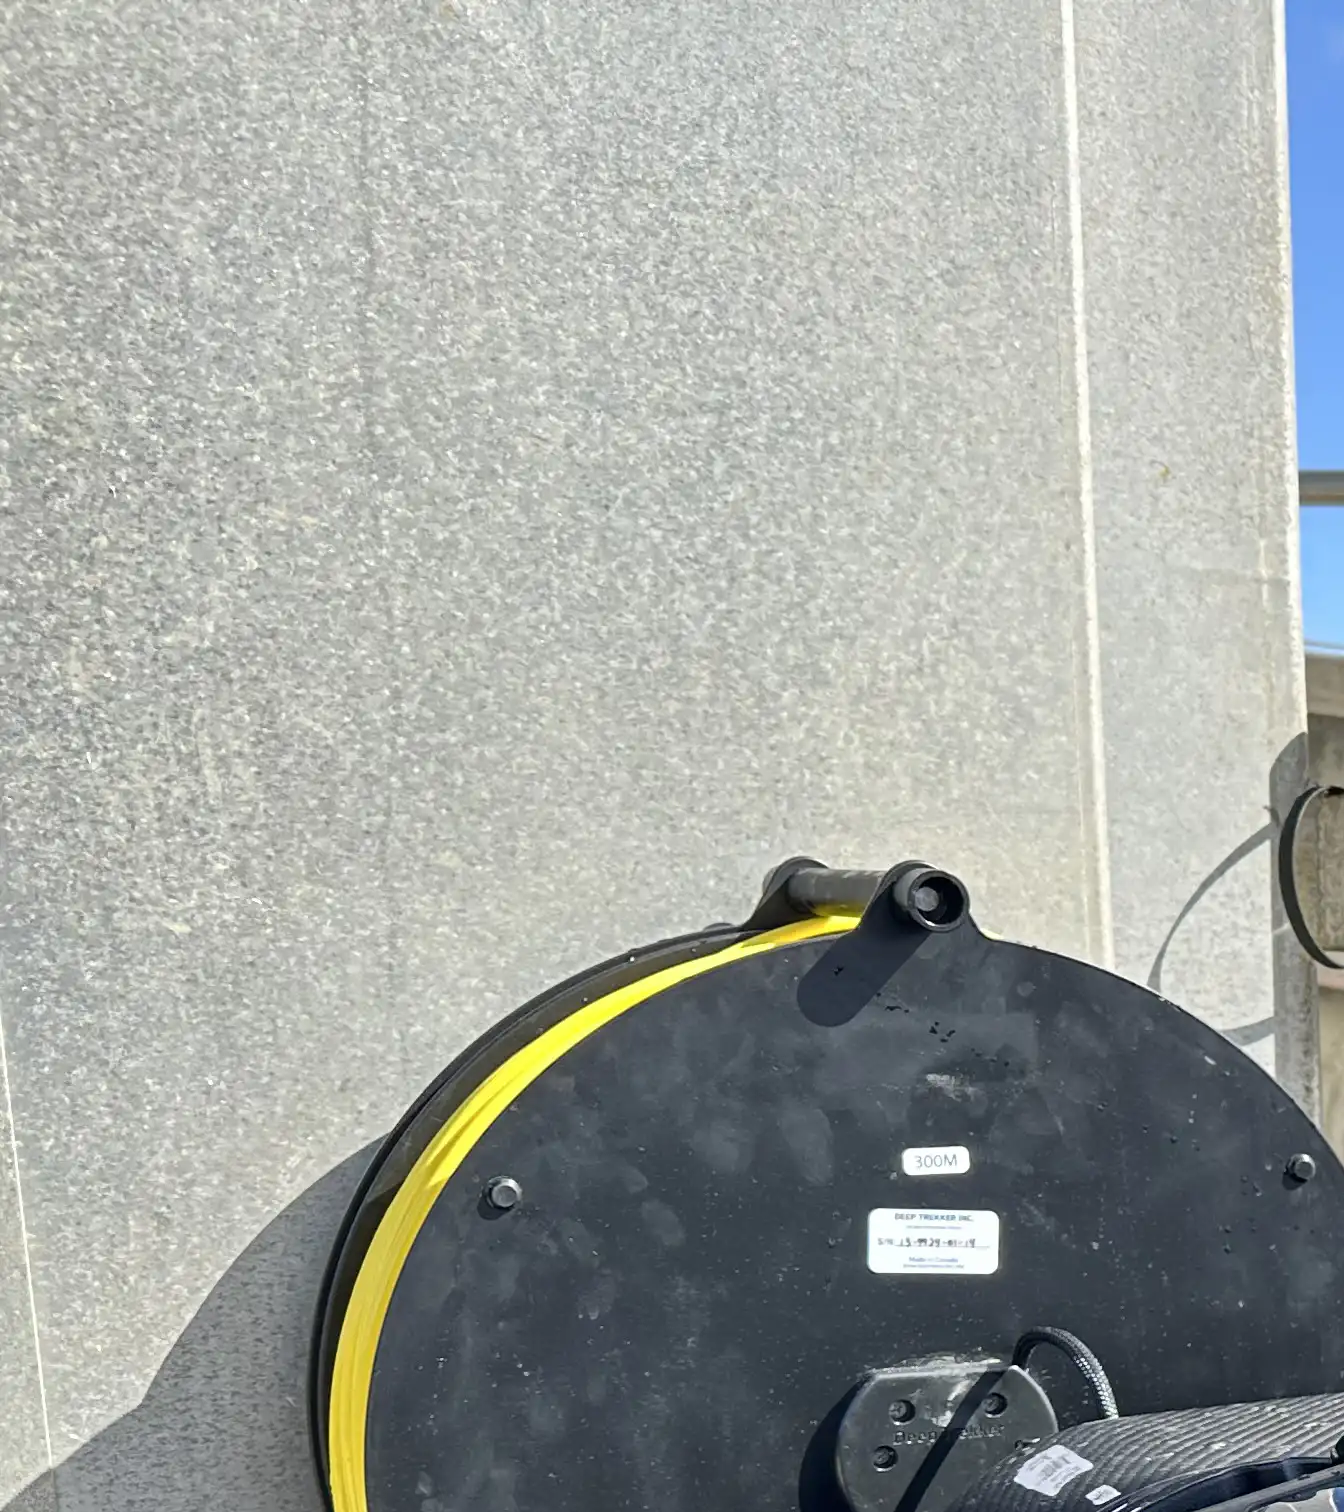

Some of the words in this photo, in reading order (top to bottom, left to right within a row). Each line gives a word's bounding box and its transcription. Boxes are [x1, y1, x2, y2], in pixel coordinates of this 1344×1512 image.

[914, 1153, 958, 1169] 300M
[894, 1213, 917, 1222] DEEP
[919, 1213, 957, 1223] TREKKER
